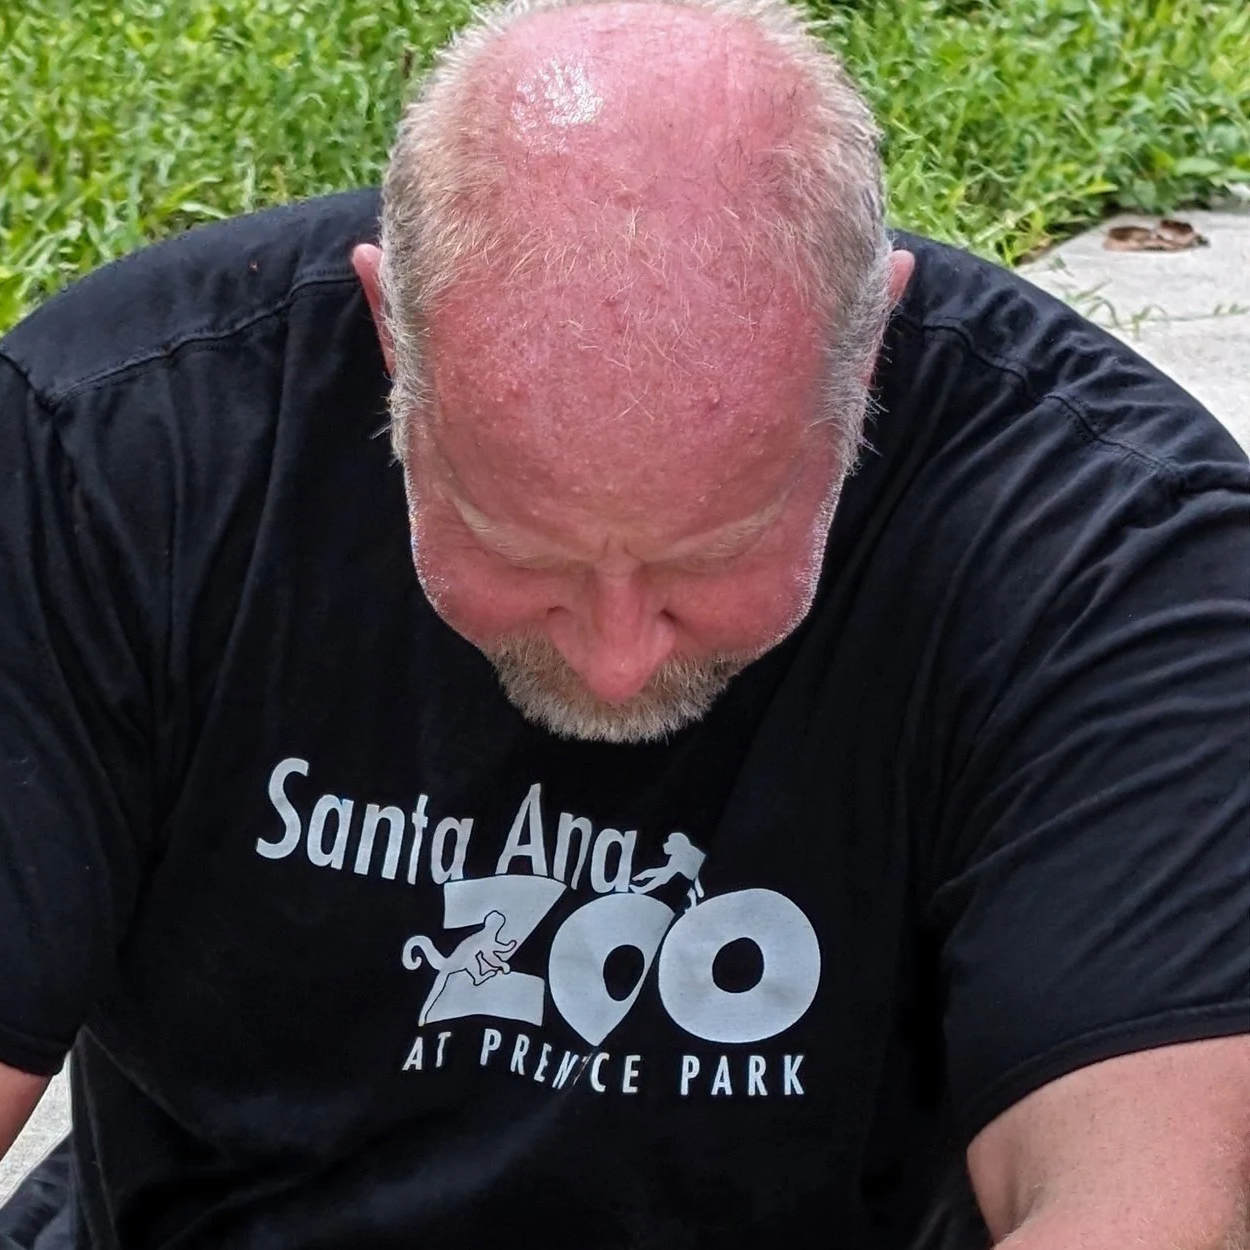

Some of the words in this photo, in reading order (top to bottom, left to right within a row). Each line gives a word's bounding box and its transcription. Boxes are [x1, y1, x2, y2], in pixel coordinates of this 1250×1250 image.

[256, 757, 474, 886] Santa
[495, 783, 638, 894] Ana
[420, 874, 822, 1047] ZOO
[401, 1032, 453, 1072] AT
[680, 1054, 805, 1096] PARK
